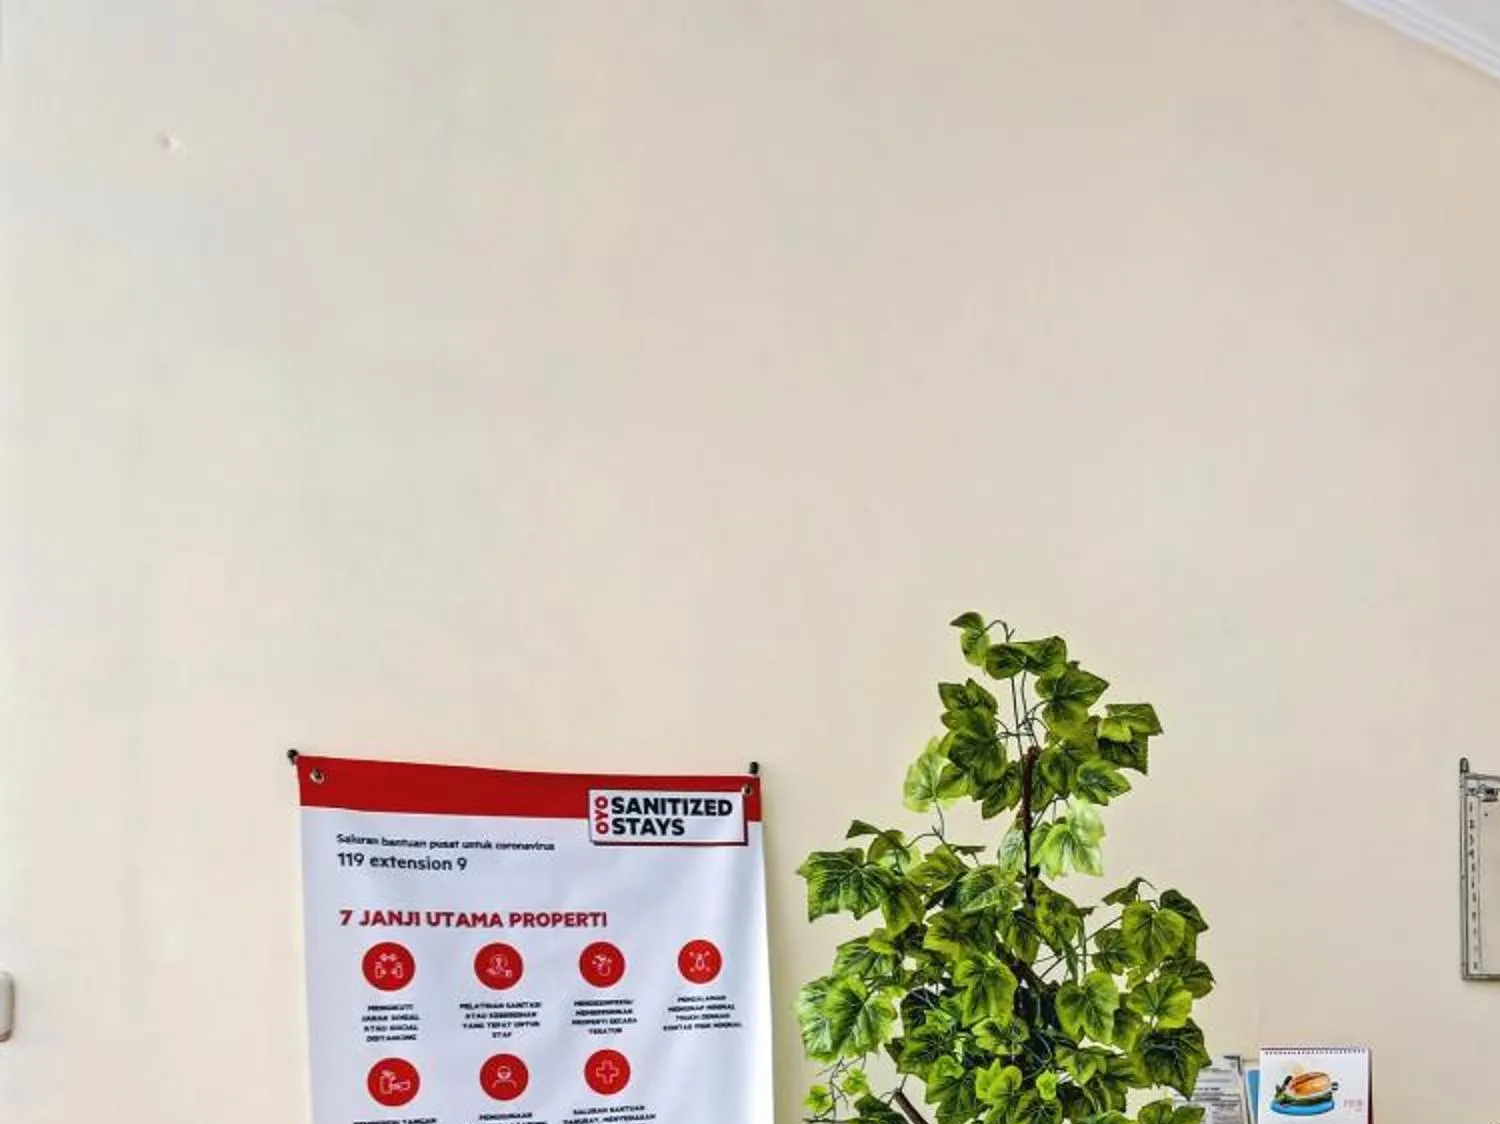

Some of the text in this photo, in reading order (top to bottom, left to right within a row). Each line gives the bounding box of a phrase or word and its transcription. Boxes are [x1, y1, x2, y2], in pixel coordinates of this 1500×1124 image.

[595, 796, 609, 835] OYO
[611, 796, 733, 817] SANITIZED
[611, 817, 685, 836] STAYS
[337, 853, 467, 871] 119 extension 9
[339, 909, 607, 928] 7 JANJI UTAMA PROPERTI
